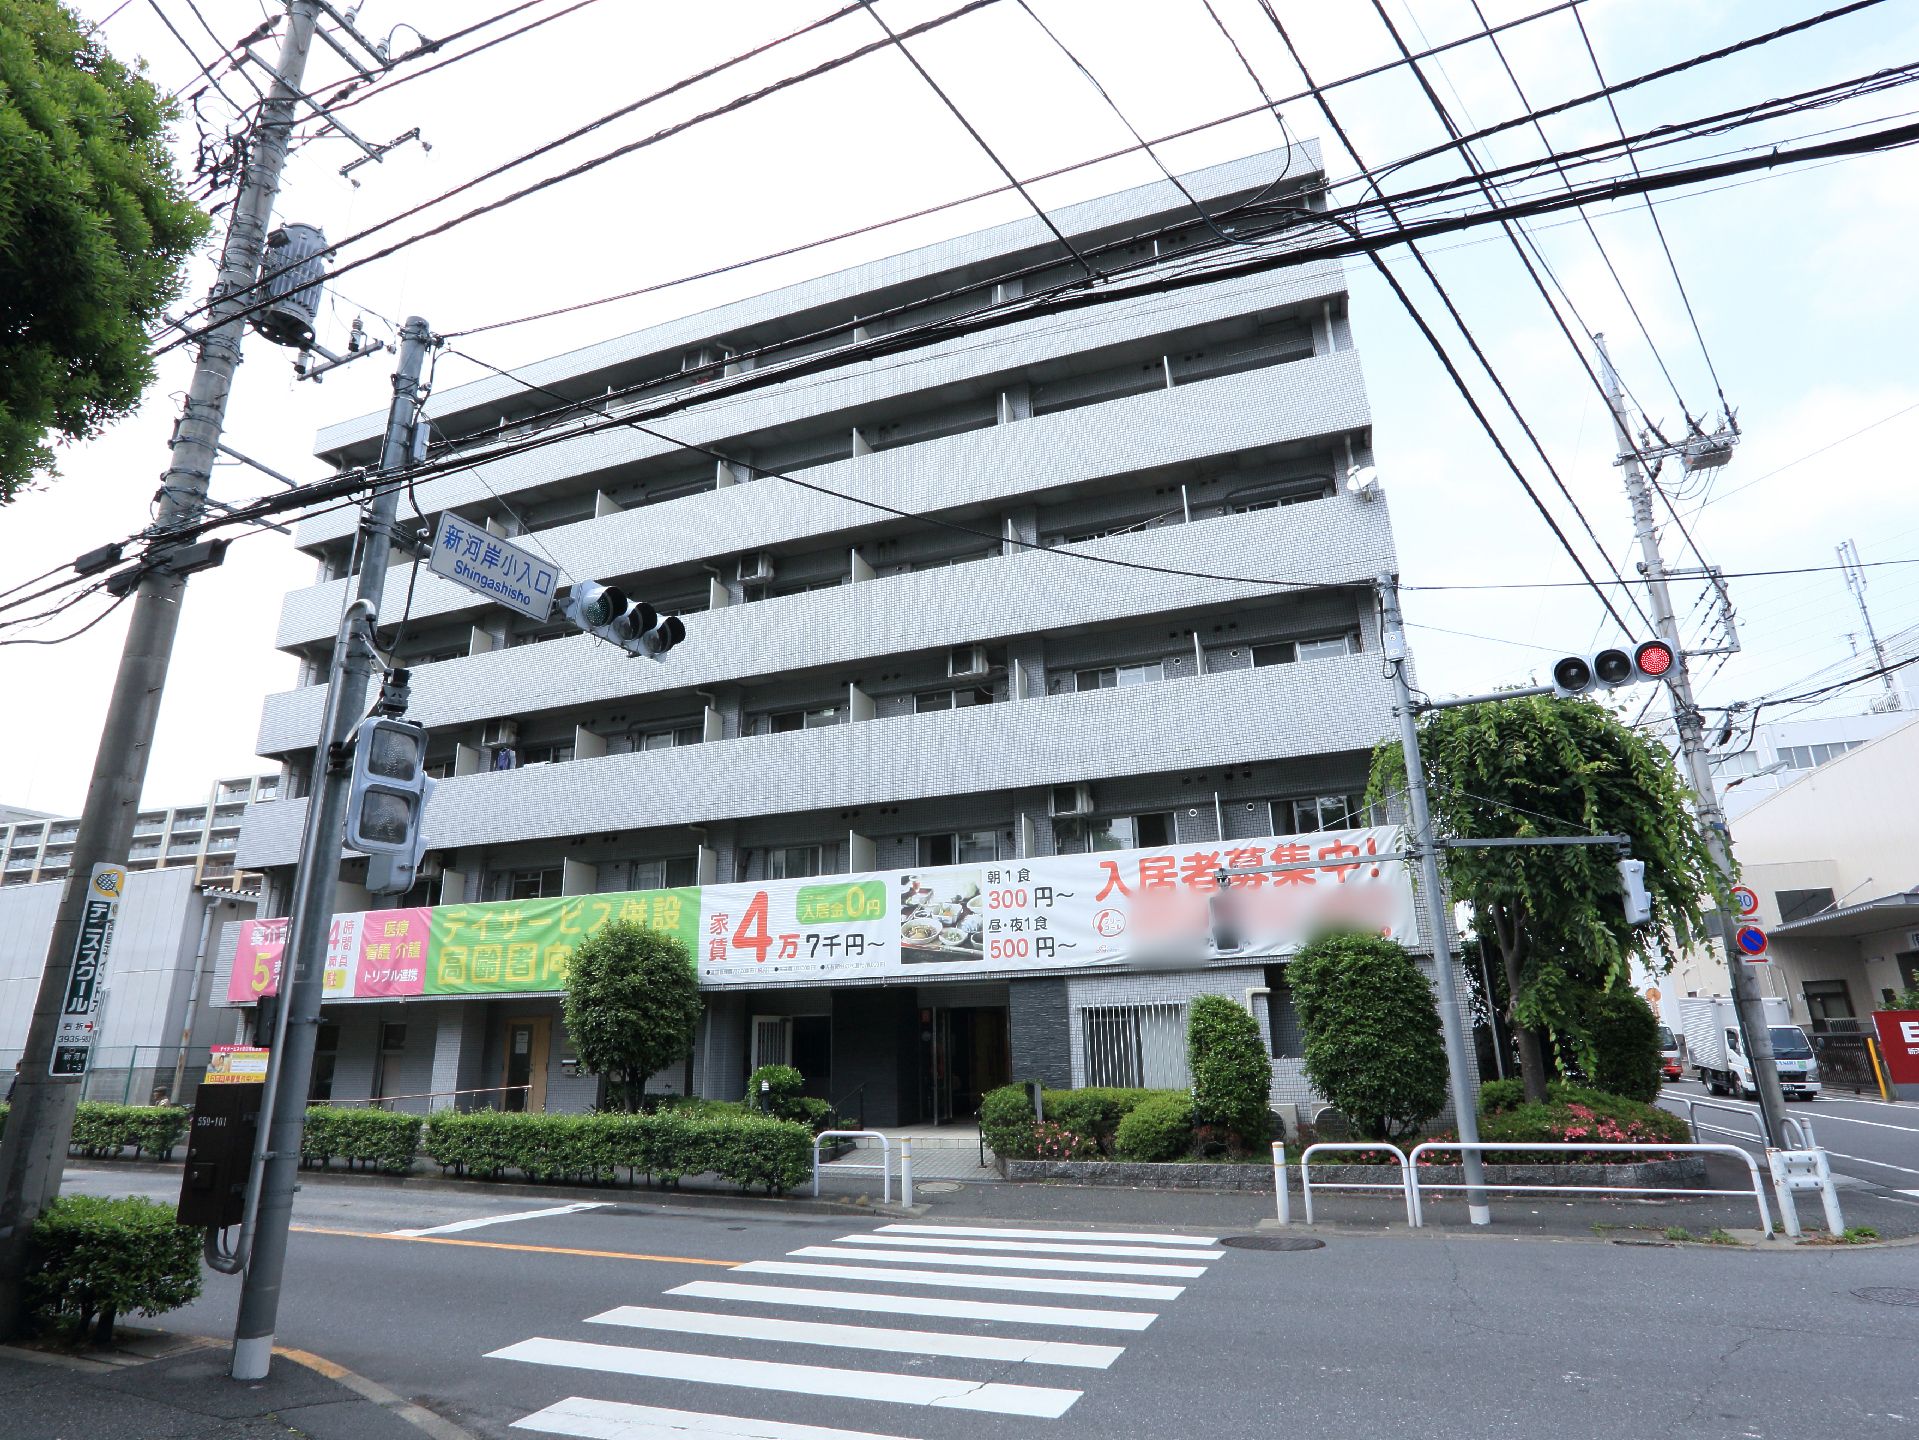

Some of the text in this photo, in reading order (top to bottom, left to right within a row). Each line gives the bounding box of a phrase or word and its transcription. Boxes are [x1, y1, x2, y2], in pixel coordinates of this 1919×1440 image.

[442, 524, 552, 596] 新河岸小入口
[454, 559, 531, 606] Shingashisho
[987, 868, 1031, 884] 朝1食
[1095, 837, 1380, 902] 入居者募集中!
[442, 896, 683, 943] デイサービス併設
[801, 886, 880, 921] 入居金0円
[1735, 894, 1752, 907] 30
[366, 941, 421, 960] 看護 介護
[384, 919, 410, 937] 医療
[709, 913, 729, 962] 家賃
[68, 903, 108, 1012] テニススクール
